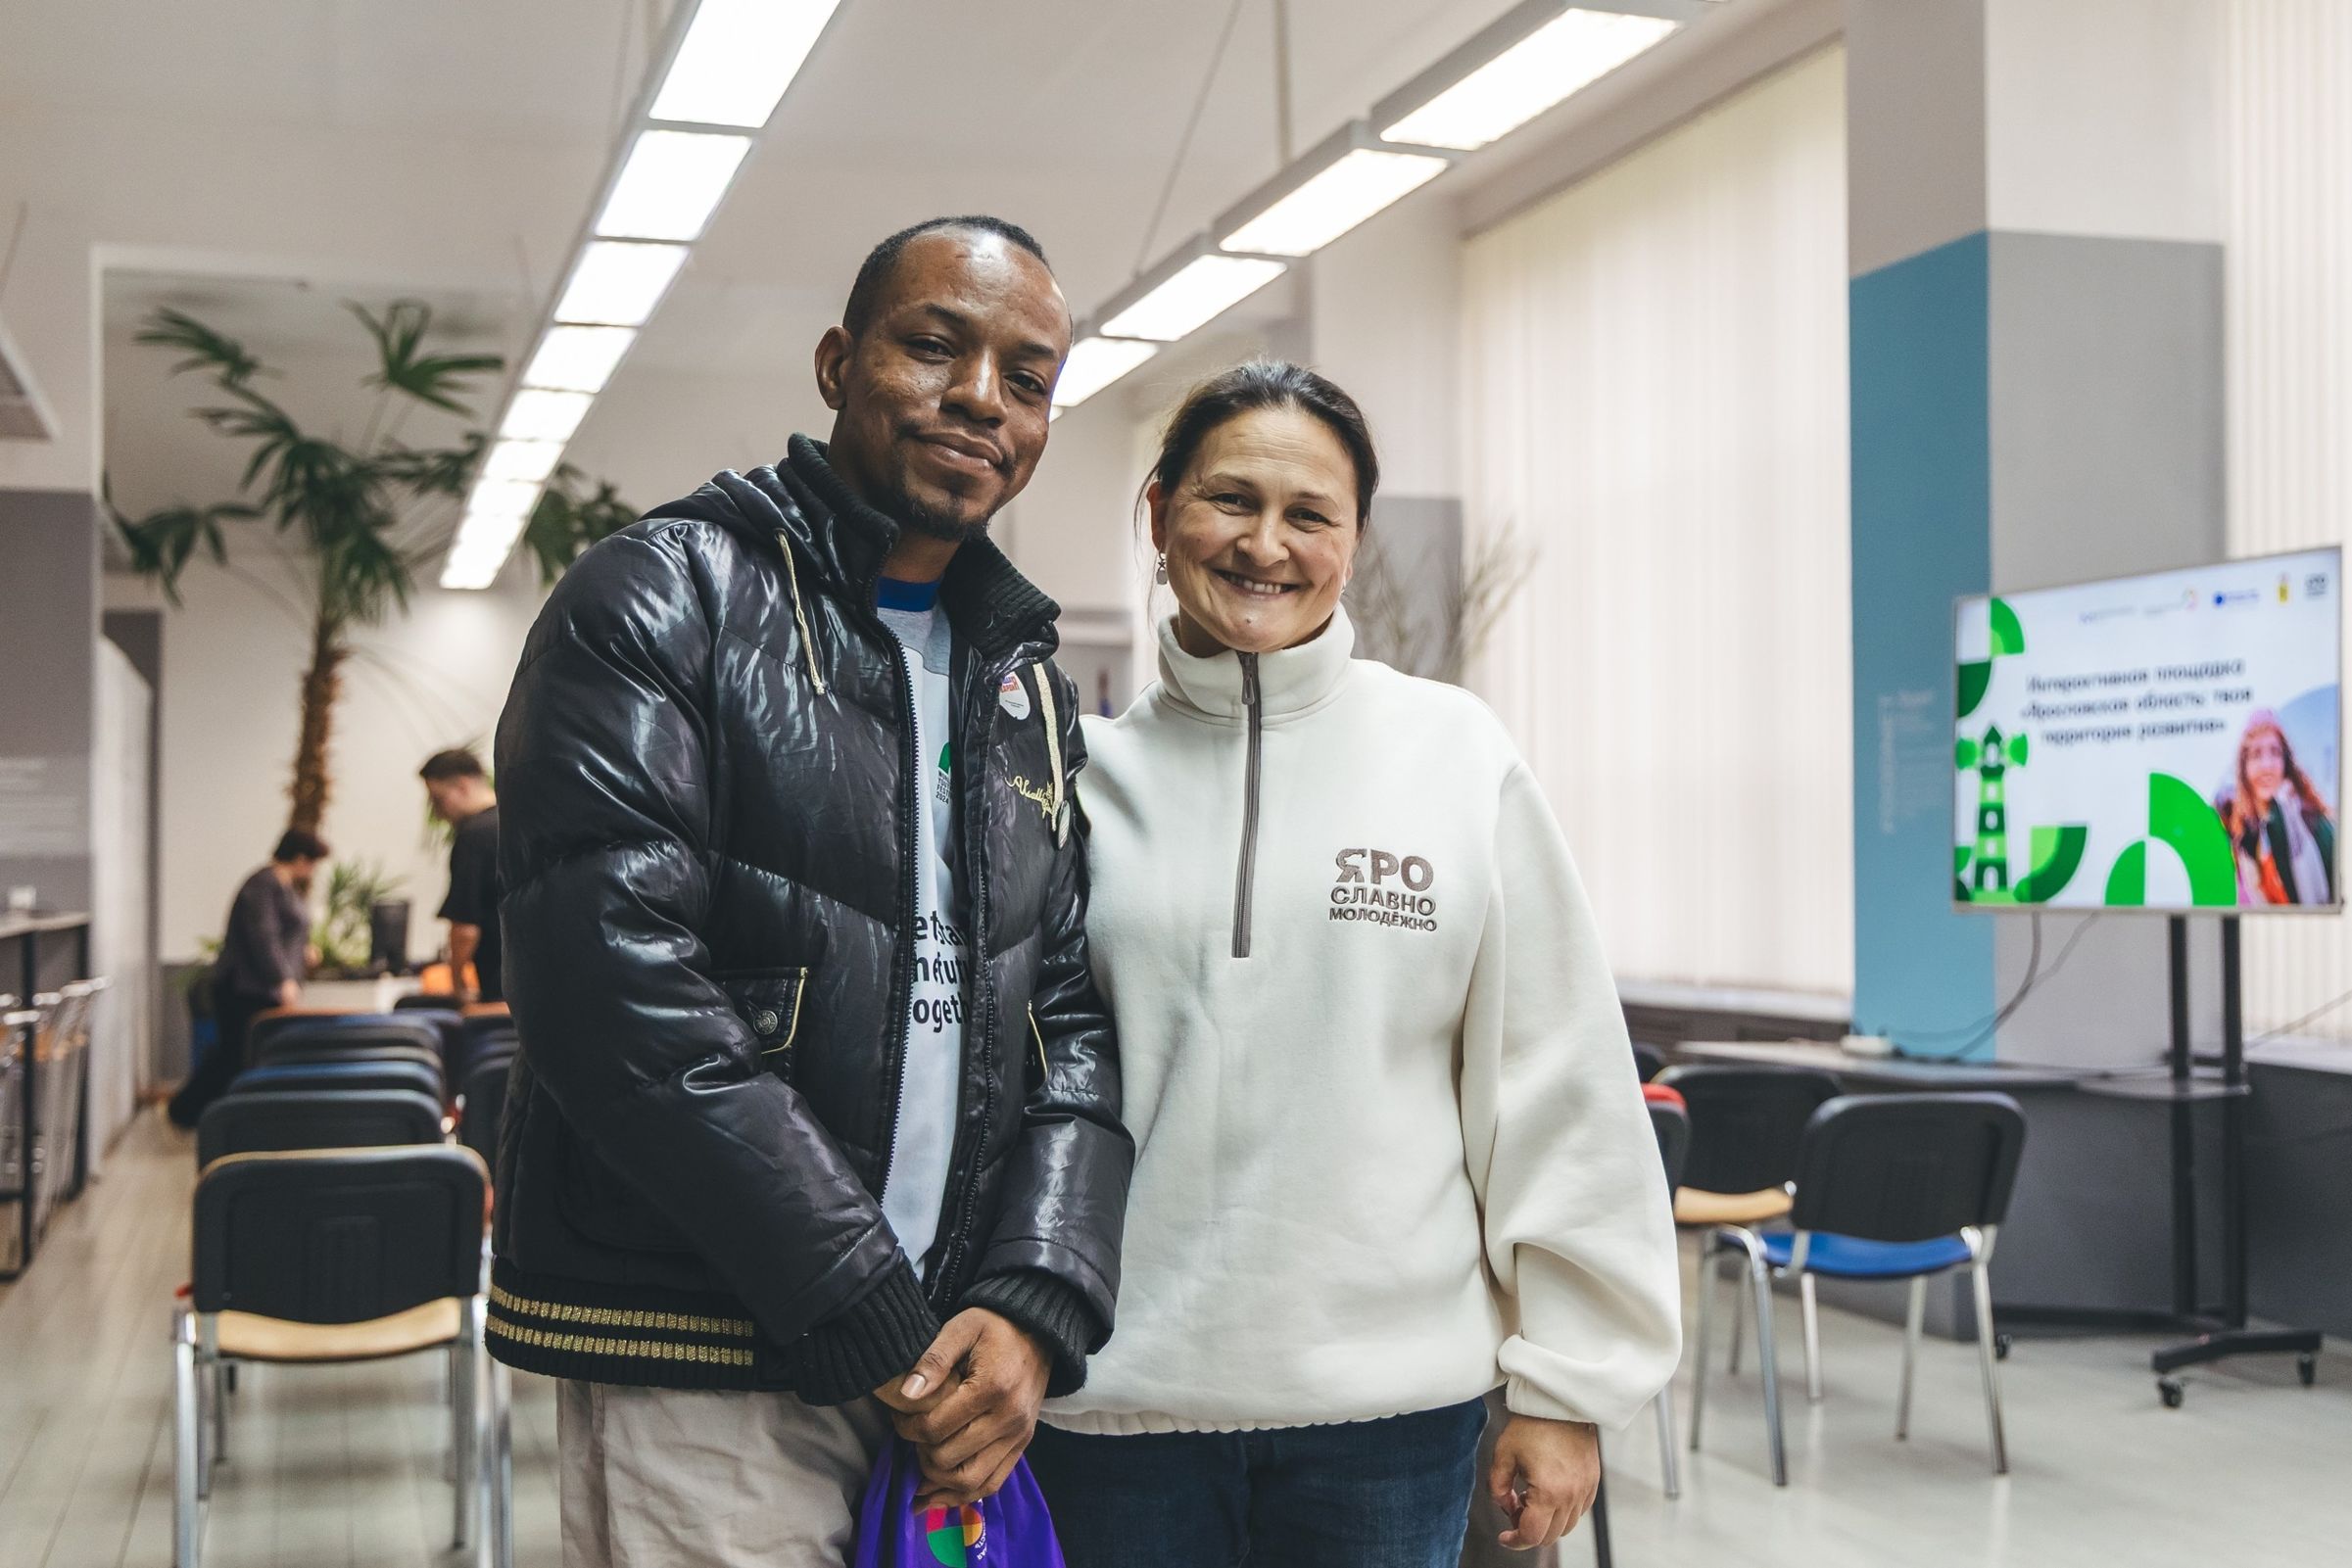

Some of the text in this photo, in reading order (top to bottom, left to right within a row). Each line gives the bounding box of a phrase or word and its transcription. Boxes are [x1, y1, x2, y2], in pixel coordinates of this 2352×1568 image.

[1335, 848, 1434, 892] ЯРО
[1330, 885, 1436, 916] СЛАВНО
[1329, 907, 1437, 932] МОЛОДЁЖНО
